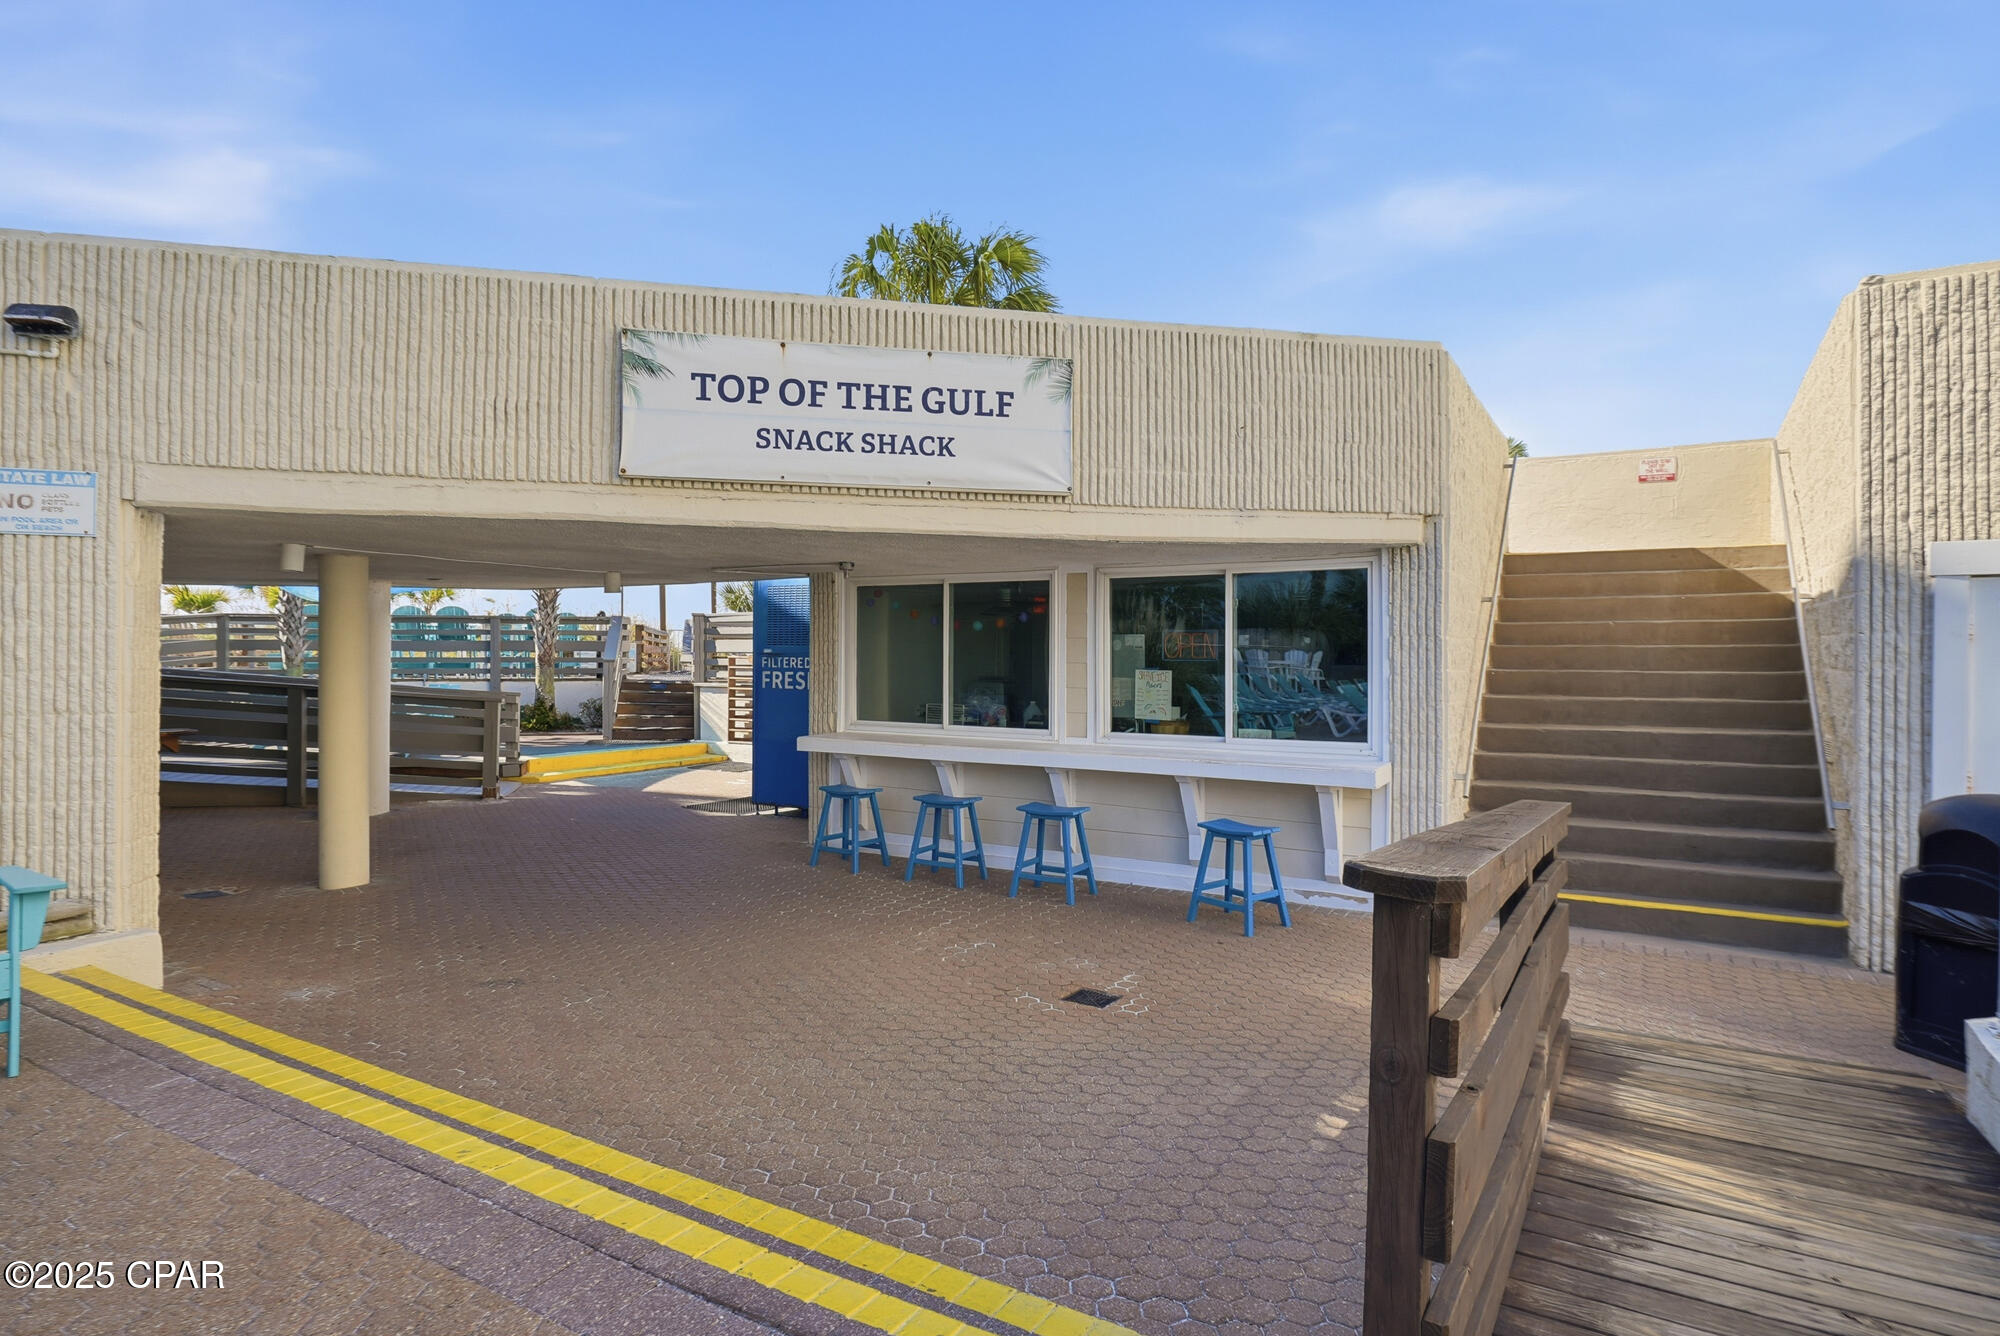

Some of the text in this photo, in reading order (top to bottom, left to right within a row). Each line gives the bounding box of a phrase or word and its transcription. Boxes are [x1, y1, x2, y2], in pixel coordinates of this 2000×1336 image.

[690, 372, 1015, 418] TOP OF THE GULF
[755, 427, 956, 457] SNACK SHACK
[0, 470, 92, 485] TATE LAW
[0, 493, 34, 510] NO
[1163, 631, 1217, 660] OPEN
[761, 656, 810, 669] FILTERED
[761, 671, 810, 690] FRES
